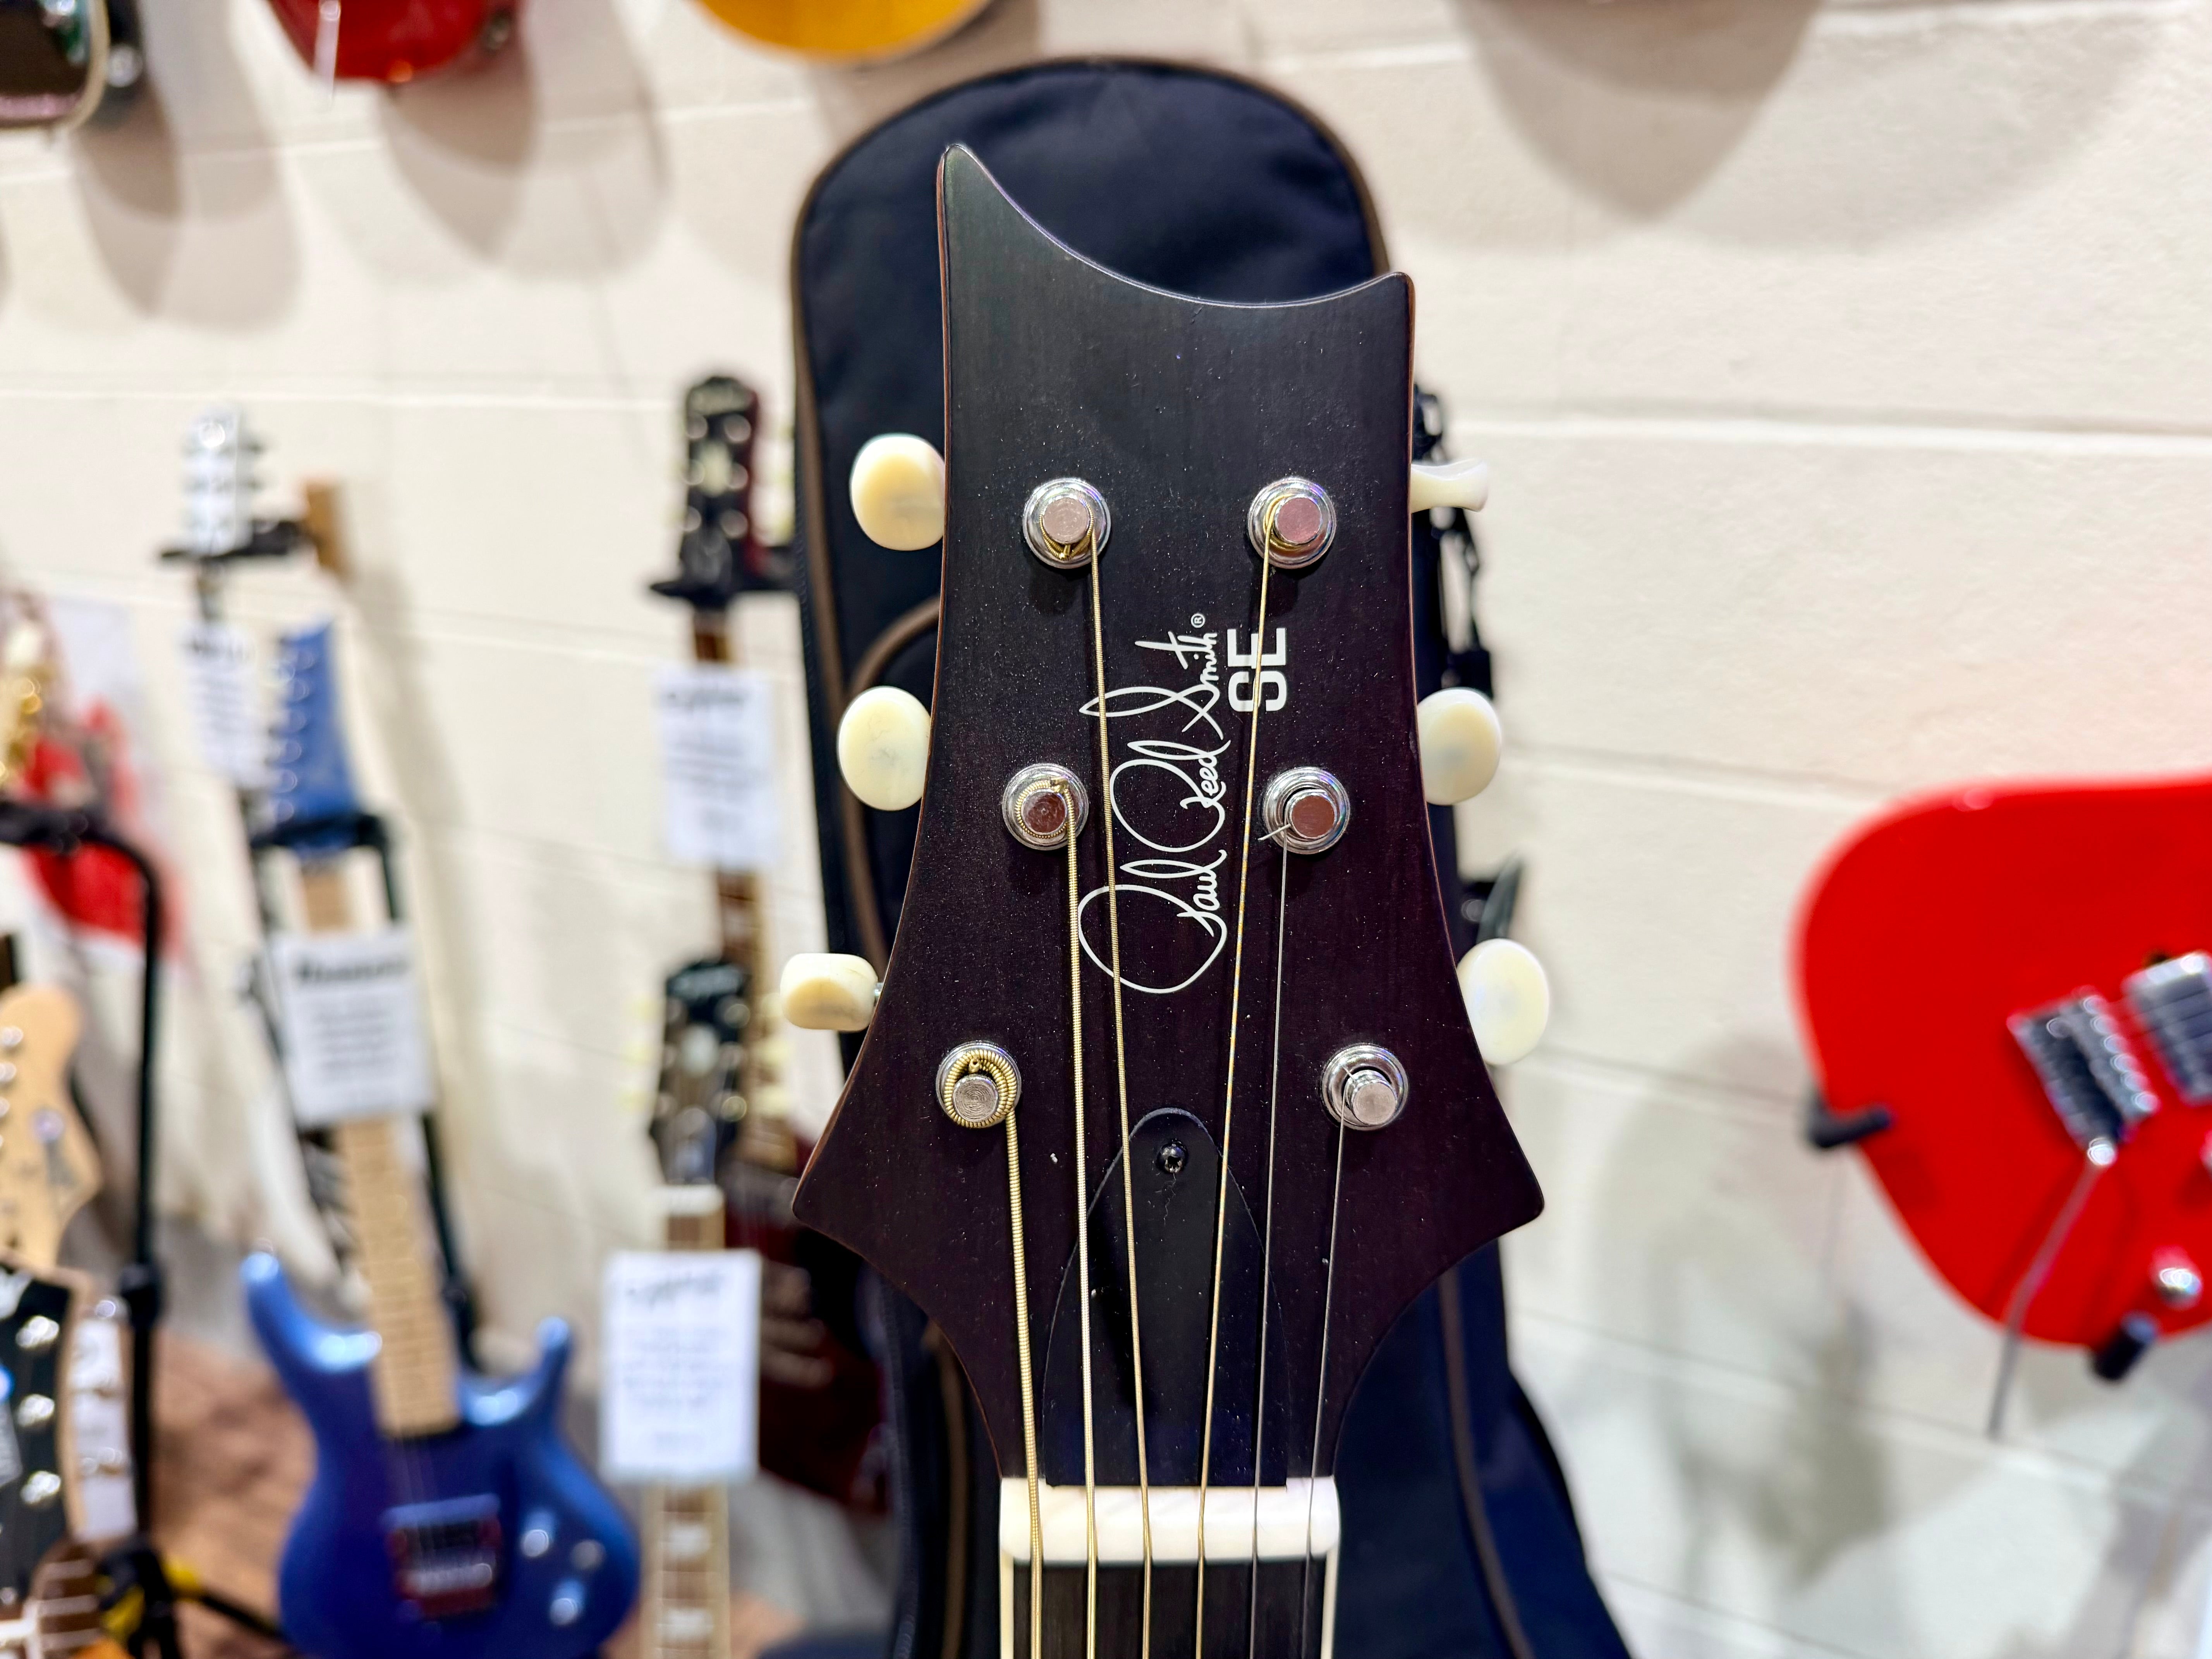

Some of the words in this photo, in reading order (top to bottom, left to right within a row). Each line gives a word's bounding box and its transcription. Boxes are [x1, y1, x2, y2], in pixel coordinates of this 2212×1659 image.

[1227, 627, 1287, 713] SE
[1109, 739, 1231, 853] Reed
[1078, 849, 1228, 994] Paul
